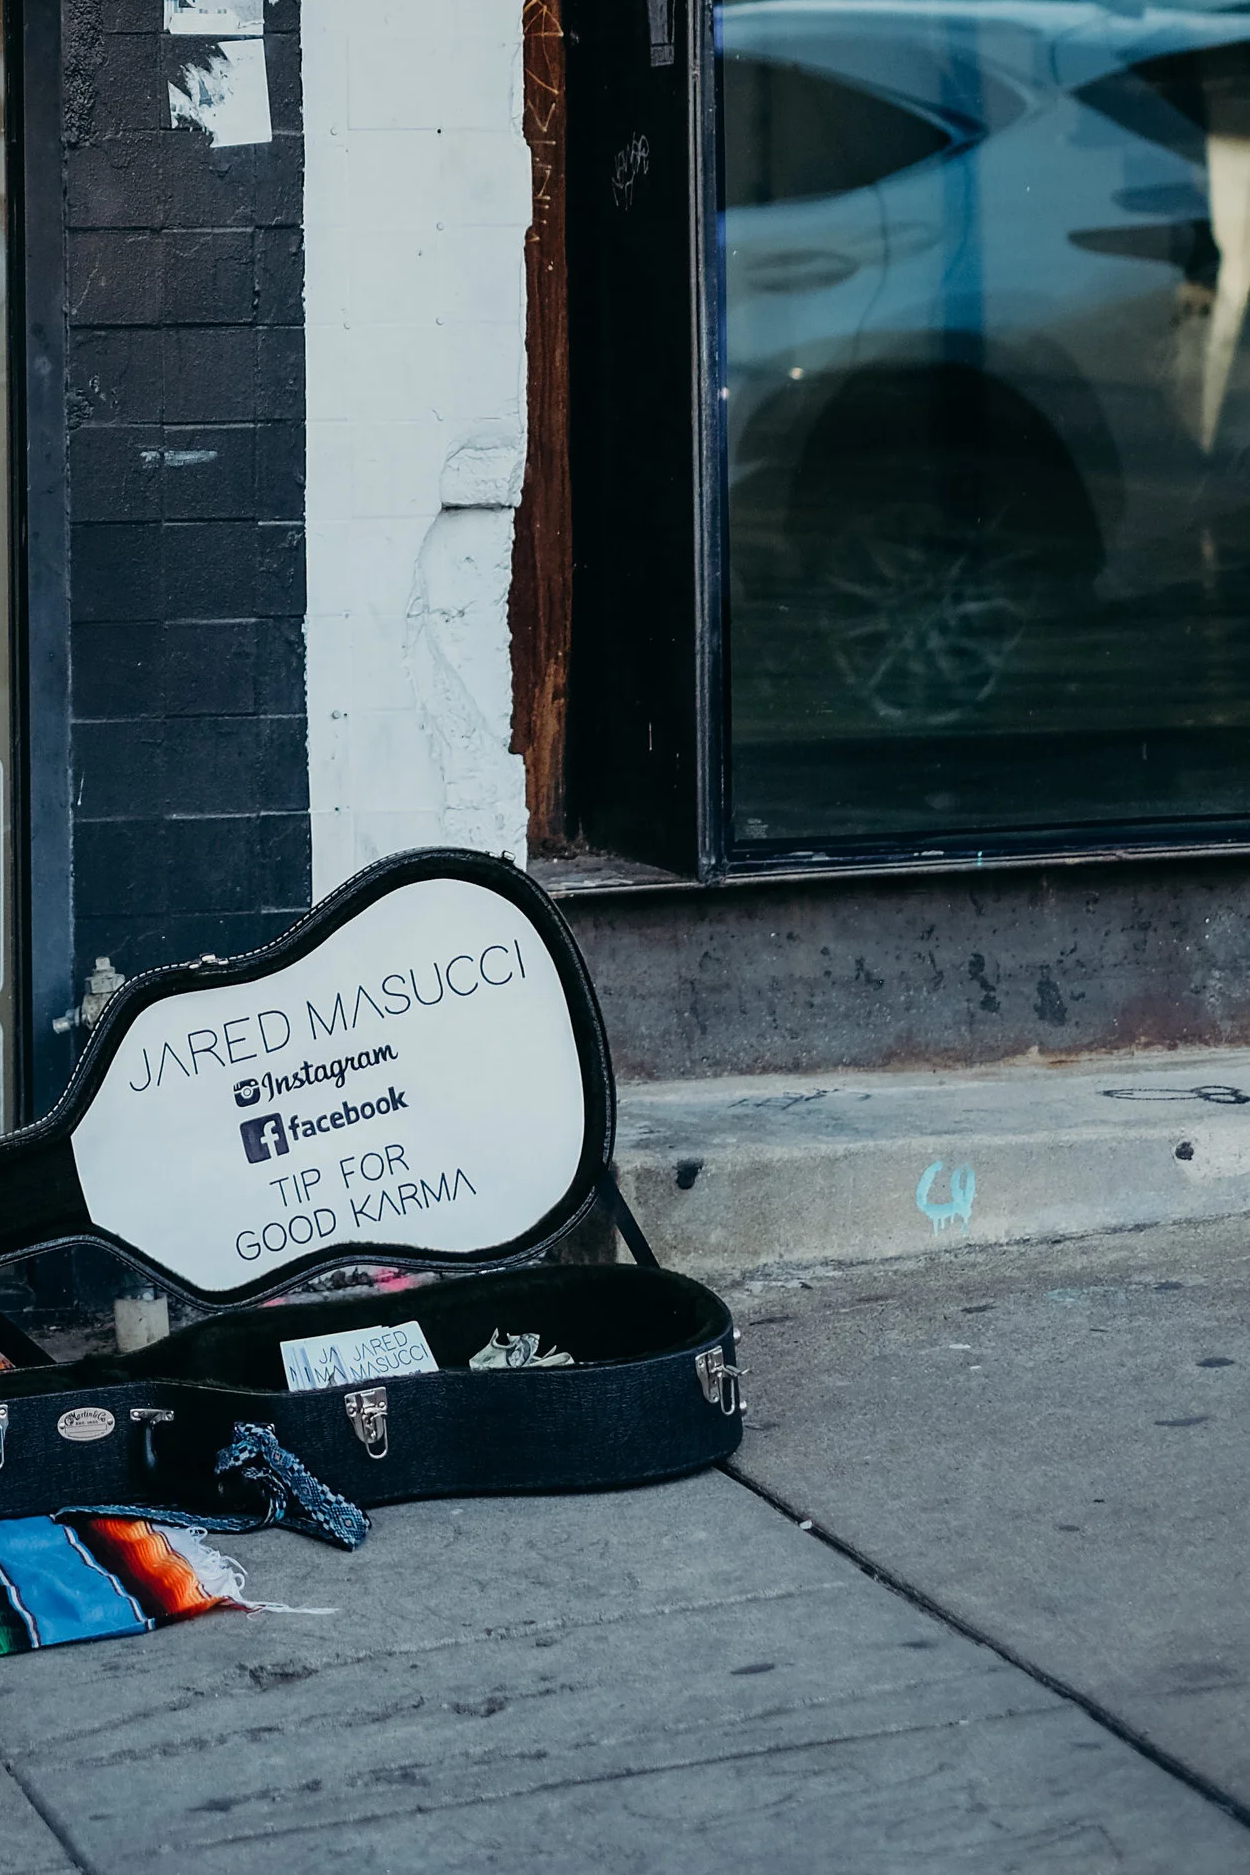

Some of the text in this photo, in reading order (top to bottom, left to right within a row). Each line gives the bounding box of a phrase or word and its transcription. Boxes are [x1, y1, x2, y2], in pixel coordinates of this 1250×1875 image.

[129, 938, 527, 1093] JARED MASUCCI
[261, 1043, 399, 1104] Instagram
[288, 1086, 410, 1142] facebook
[269, 1143, 410, 1208] TIP FOR
[235, 1167, 477, 1262] GOOD KARMA
[349, 1342, 429, 1380] MASUCCI
[353, 1330, 408, 1362] JARED
